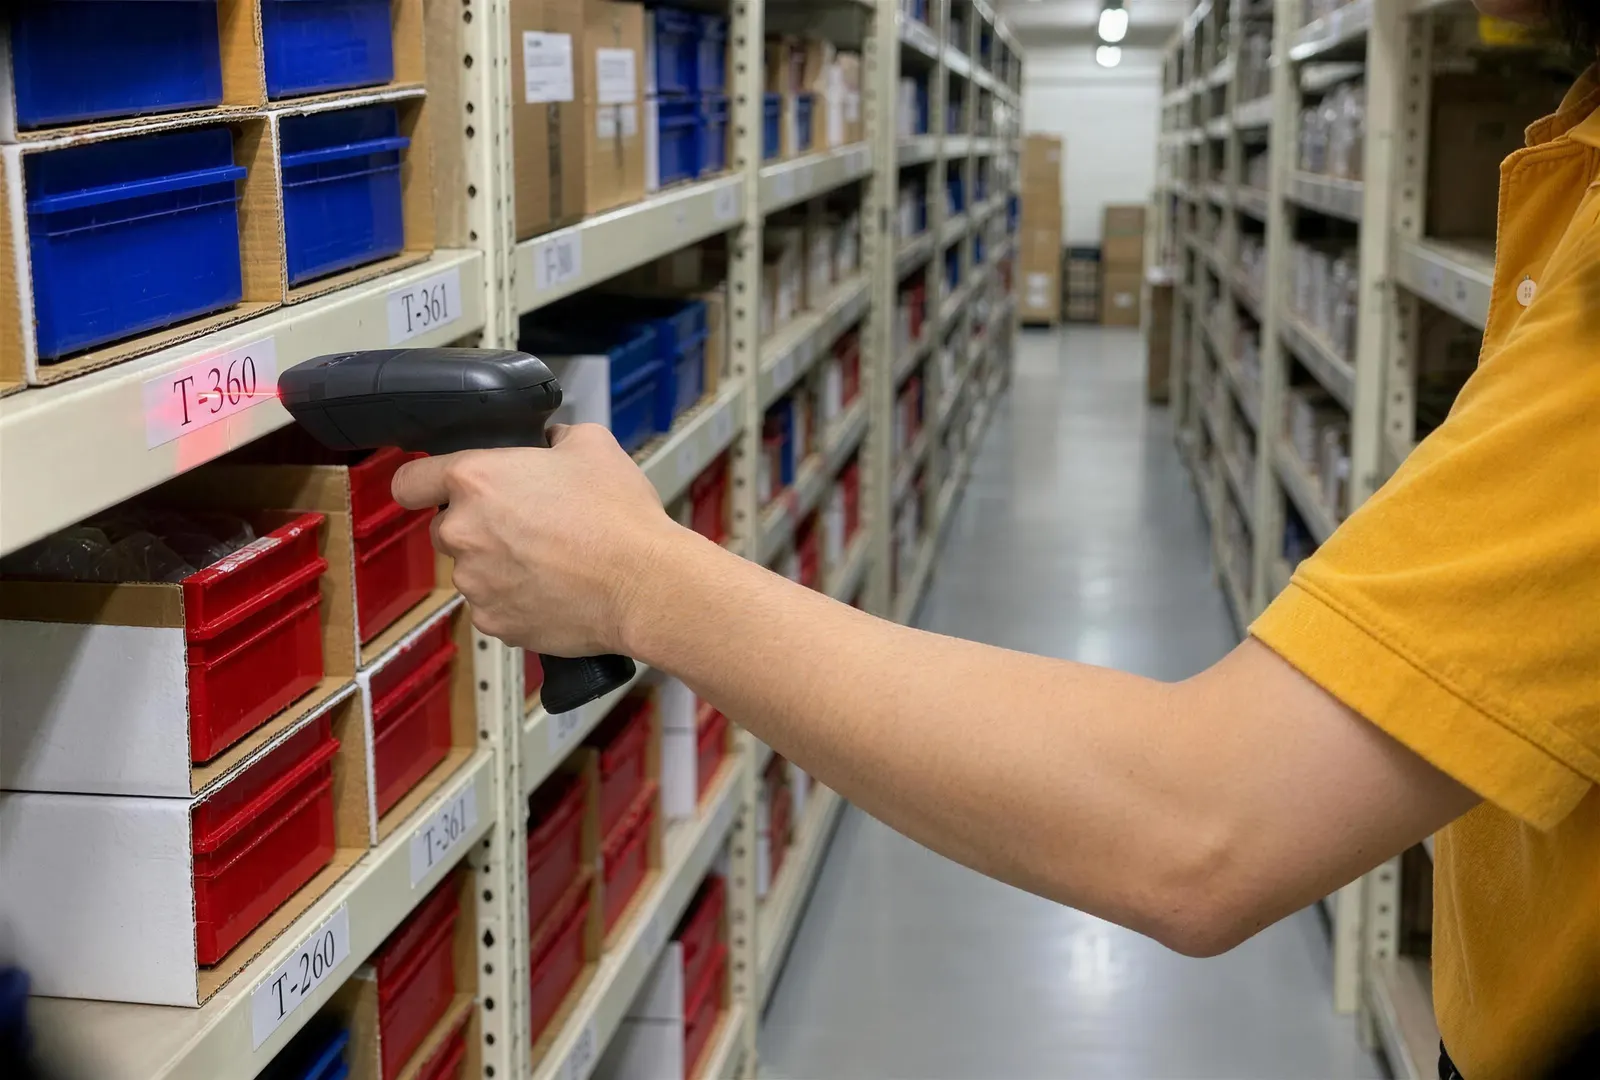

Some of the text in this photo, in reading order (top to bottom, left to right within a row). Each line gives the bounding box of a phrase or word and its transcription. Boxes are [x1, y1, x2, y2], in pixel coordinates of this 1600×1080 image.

[402, 283, 448, 333] T-361
[174, 356, 257, 426] T-360
[422, 799, 466, 867] T-361
[272, 930, 335, 1021] T-260
